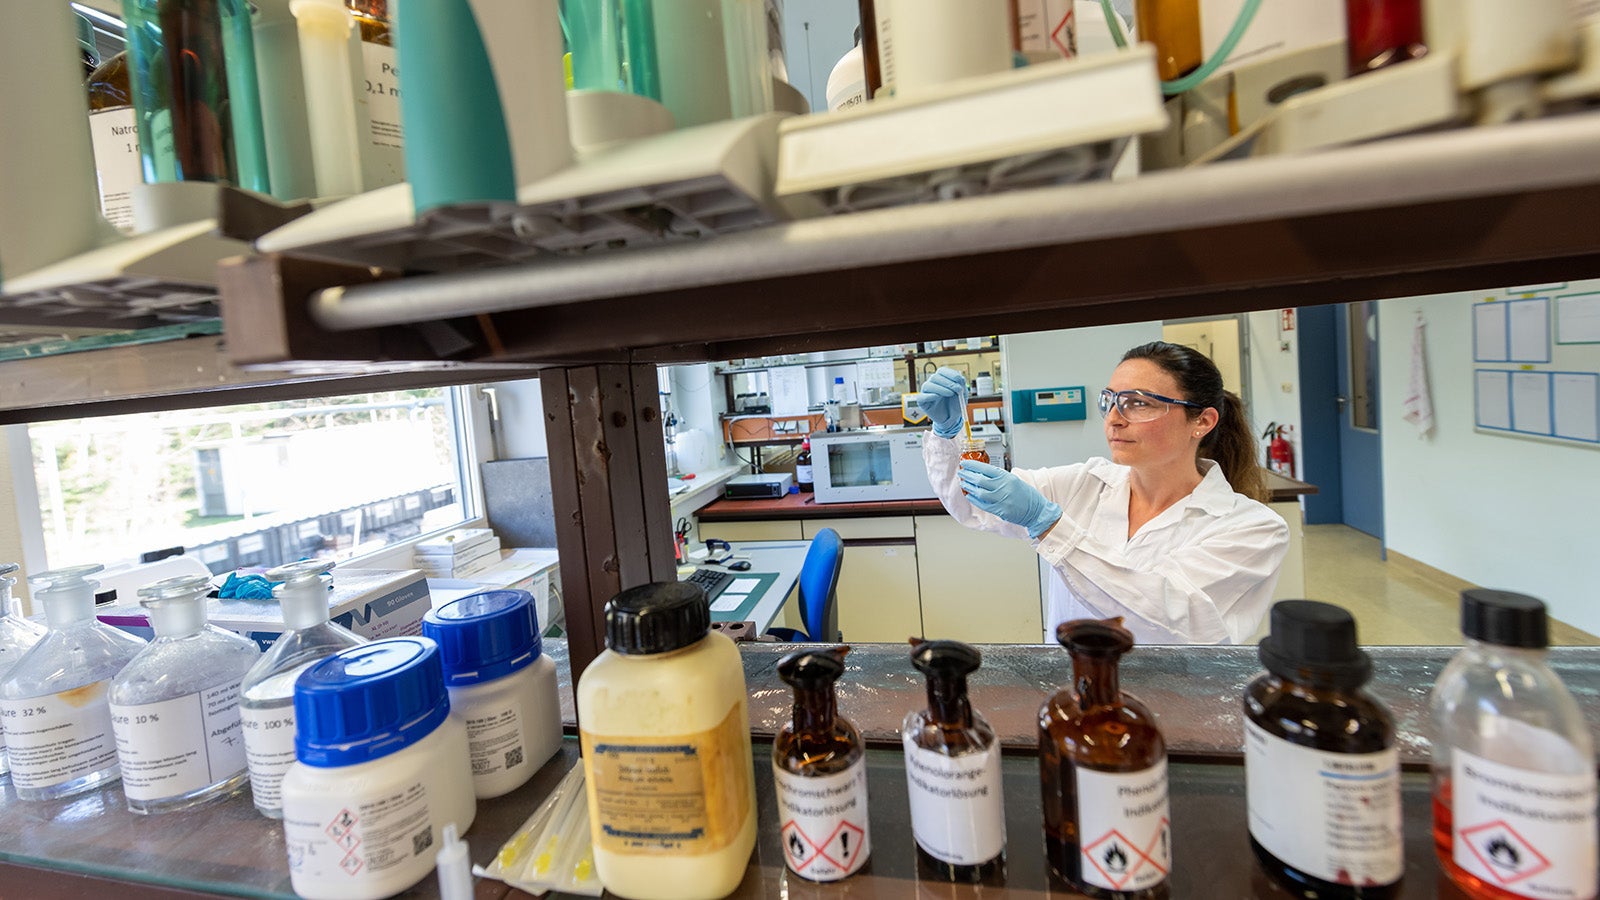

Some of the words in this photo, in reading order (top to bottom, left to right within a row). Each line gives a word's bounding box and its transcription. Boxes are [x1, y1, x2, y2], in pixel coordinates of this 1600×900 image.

[23, 708, 34, 717] 32
[36, 706, 47, 715] %
[135, 715, 148, 724] 10
[149, 713, 159, 723] %
[264, 720, 282, 730] 100
[284, 718, 294, 728] %
